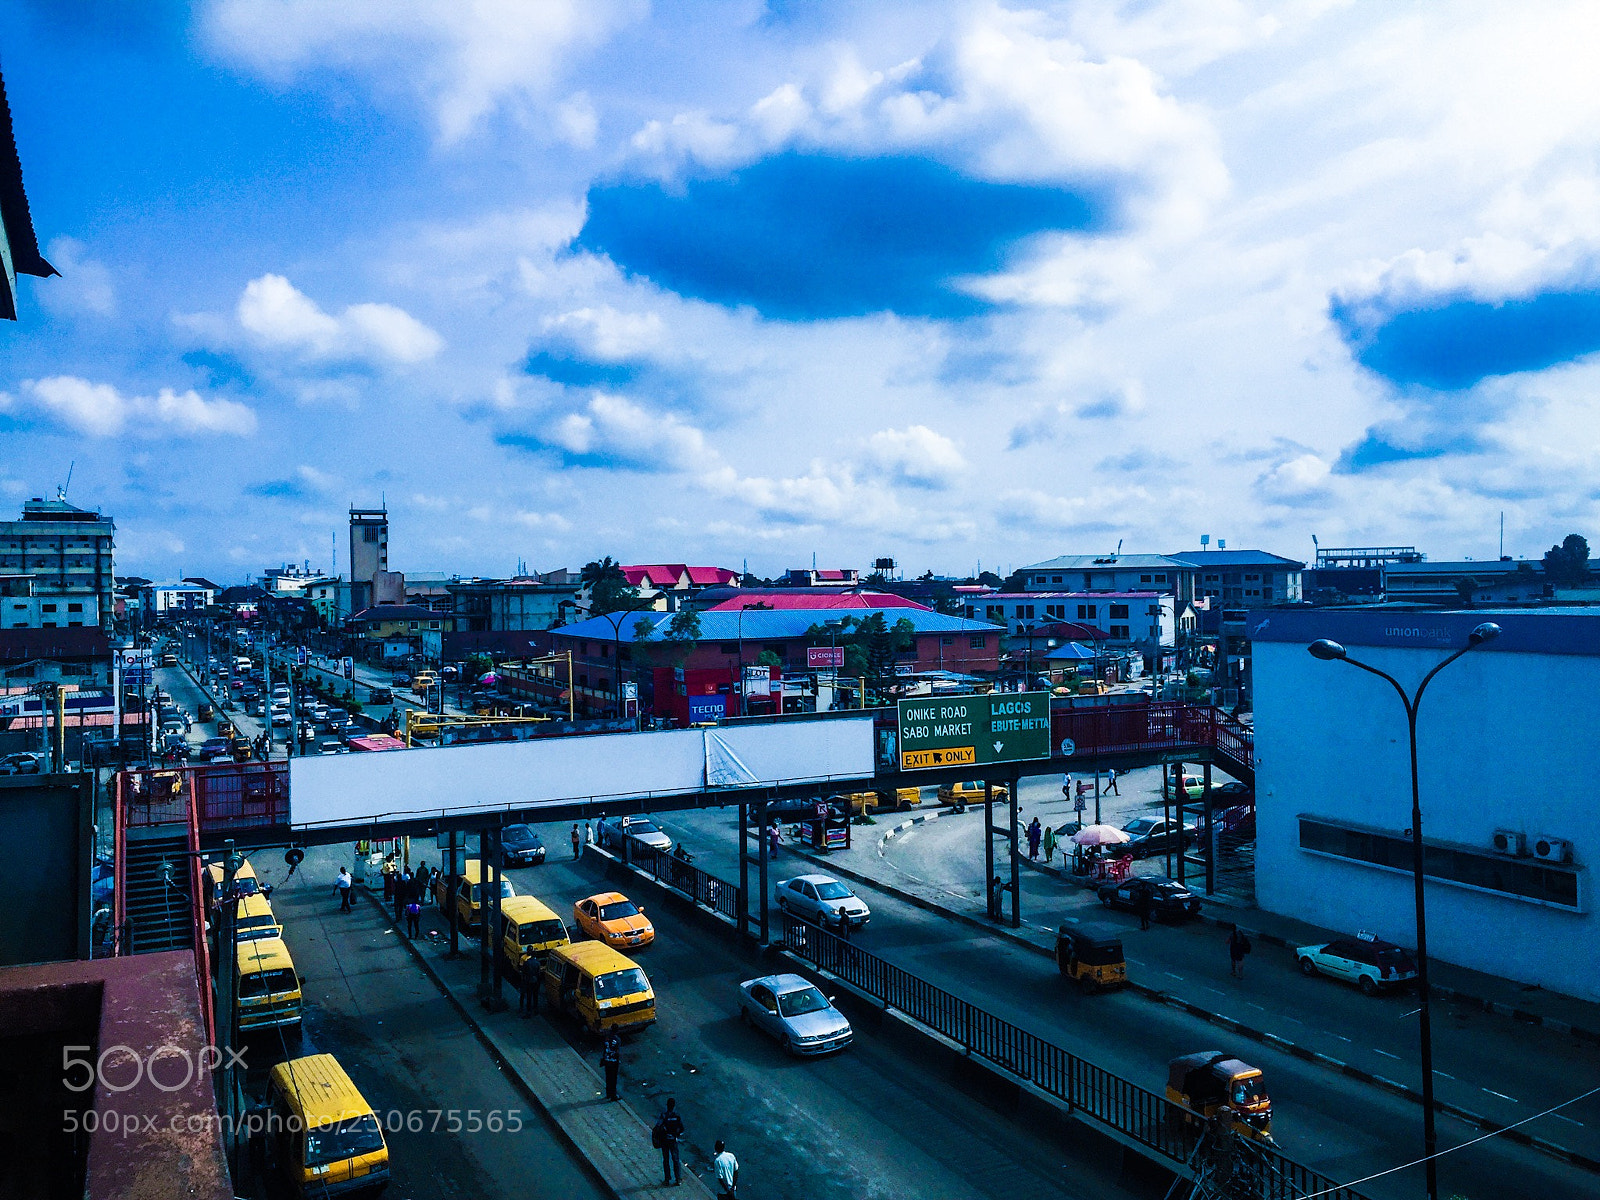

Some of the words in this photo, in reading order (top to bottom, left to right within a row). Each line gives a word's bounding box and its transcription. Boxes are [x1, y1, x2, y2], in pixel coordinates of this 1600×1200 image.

[115, 654, 150, 664] Mobil
[691, 704, 724, 714] TECNO
[906, 707, 936, 721] ONIKE
[941, 705, 967, 719] ROAD
[991, 701, 1032, 716] LAGOS
[903, 725, 929, 739] SABO
[934, 722, 972, 737] MARKET
[991, 717, 1049, 733] EBUTE-METTA
[905, 753, 930, 766] EXIT
[945, 750, 973, 763] ONLY
